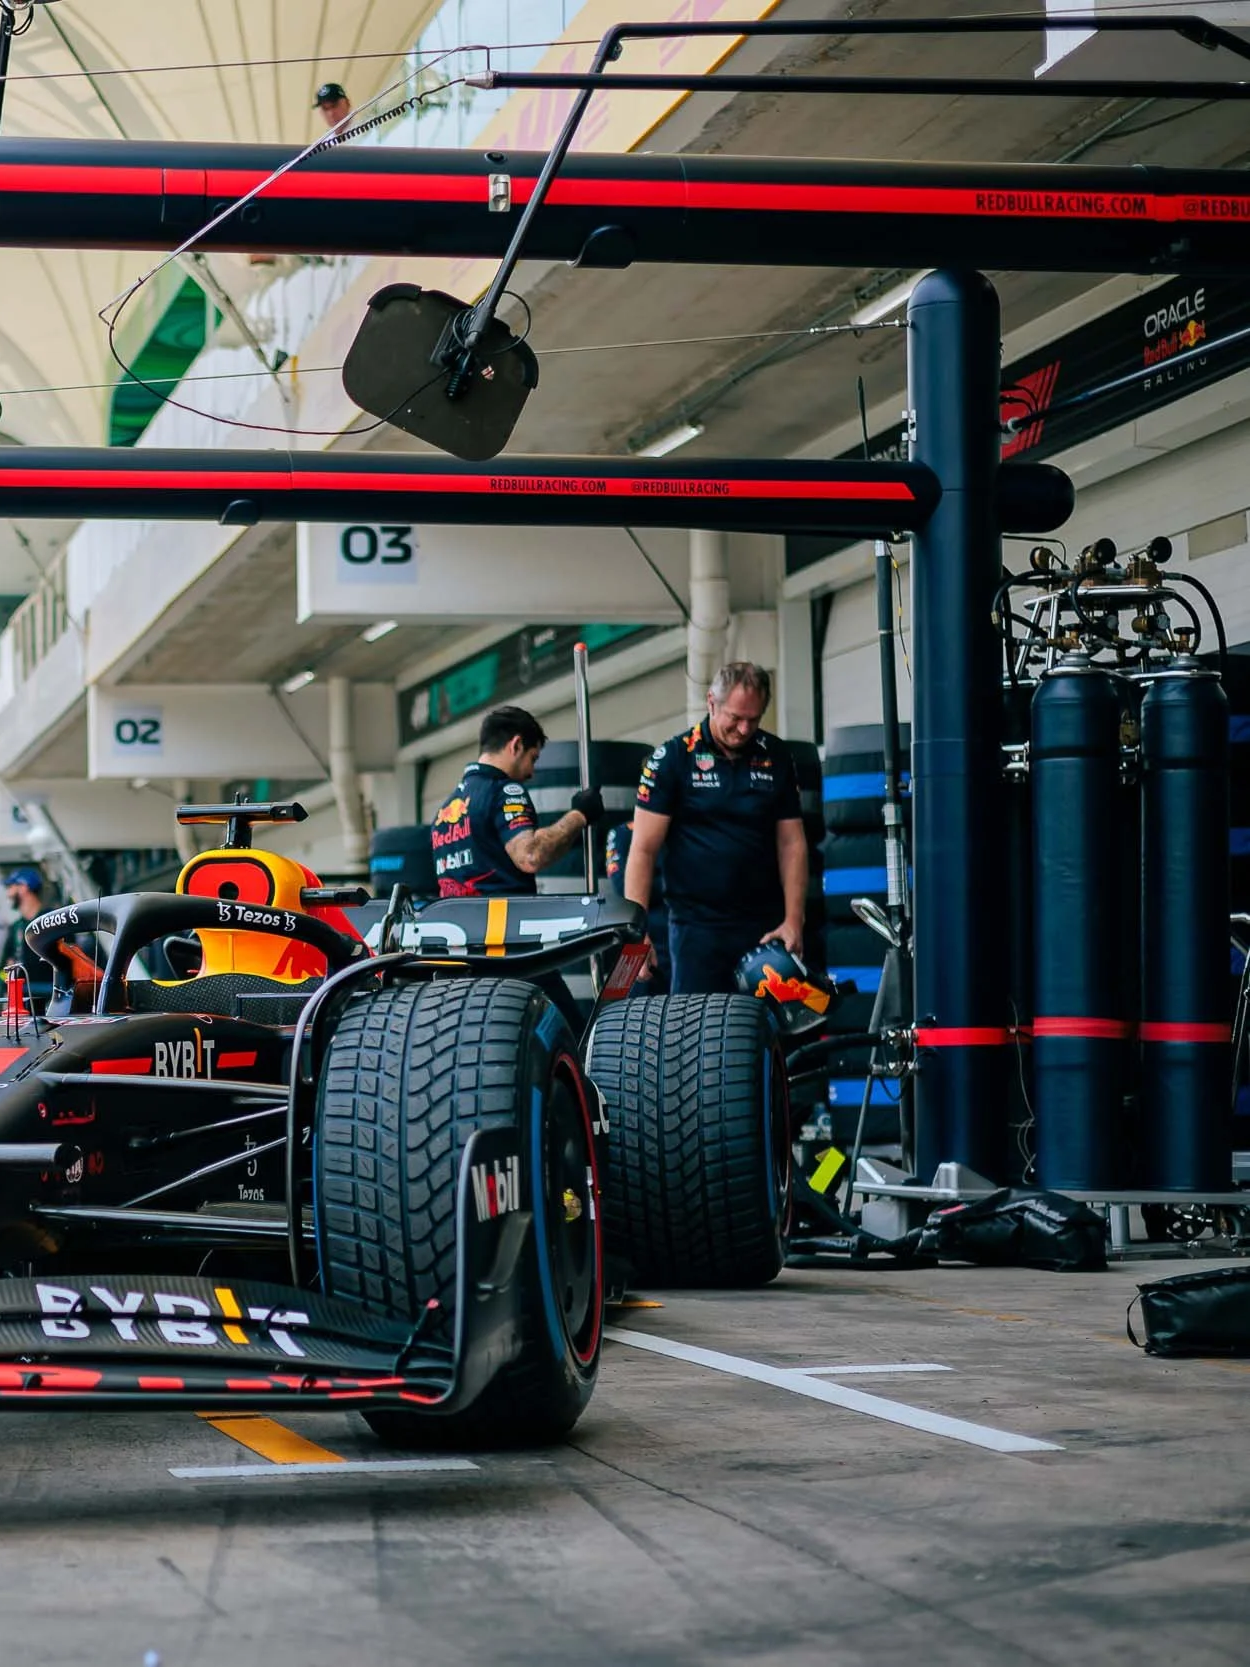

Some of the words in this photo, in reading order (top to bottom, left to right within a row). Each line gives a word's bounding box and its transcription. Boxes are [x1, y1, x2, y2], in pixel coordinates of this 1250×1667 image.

[975, 192, 1147, 215] REDBULLRACING.COM
[1144, 287, 1206, 338] ORACLE
[490, 478, 607, 493] REDBULLRACING.COM
[632, 480, 730, 496] @REDBULLRACING
[341, 525, 413, 565] 03
[115, 719, 161, 745] 02
[432, 824, 452, 850] Red
[234, 905, 281, 927] Tezos
[471, 1155, 520, 1223] Mobil
[36, 1283, 311, 1357] BYBIT
